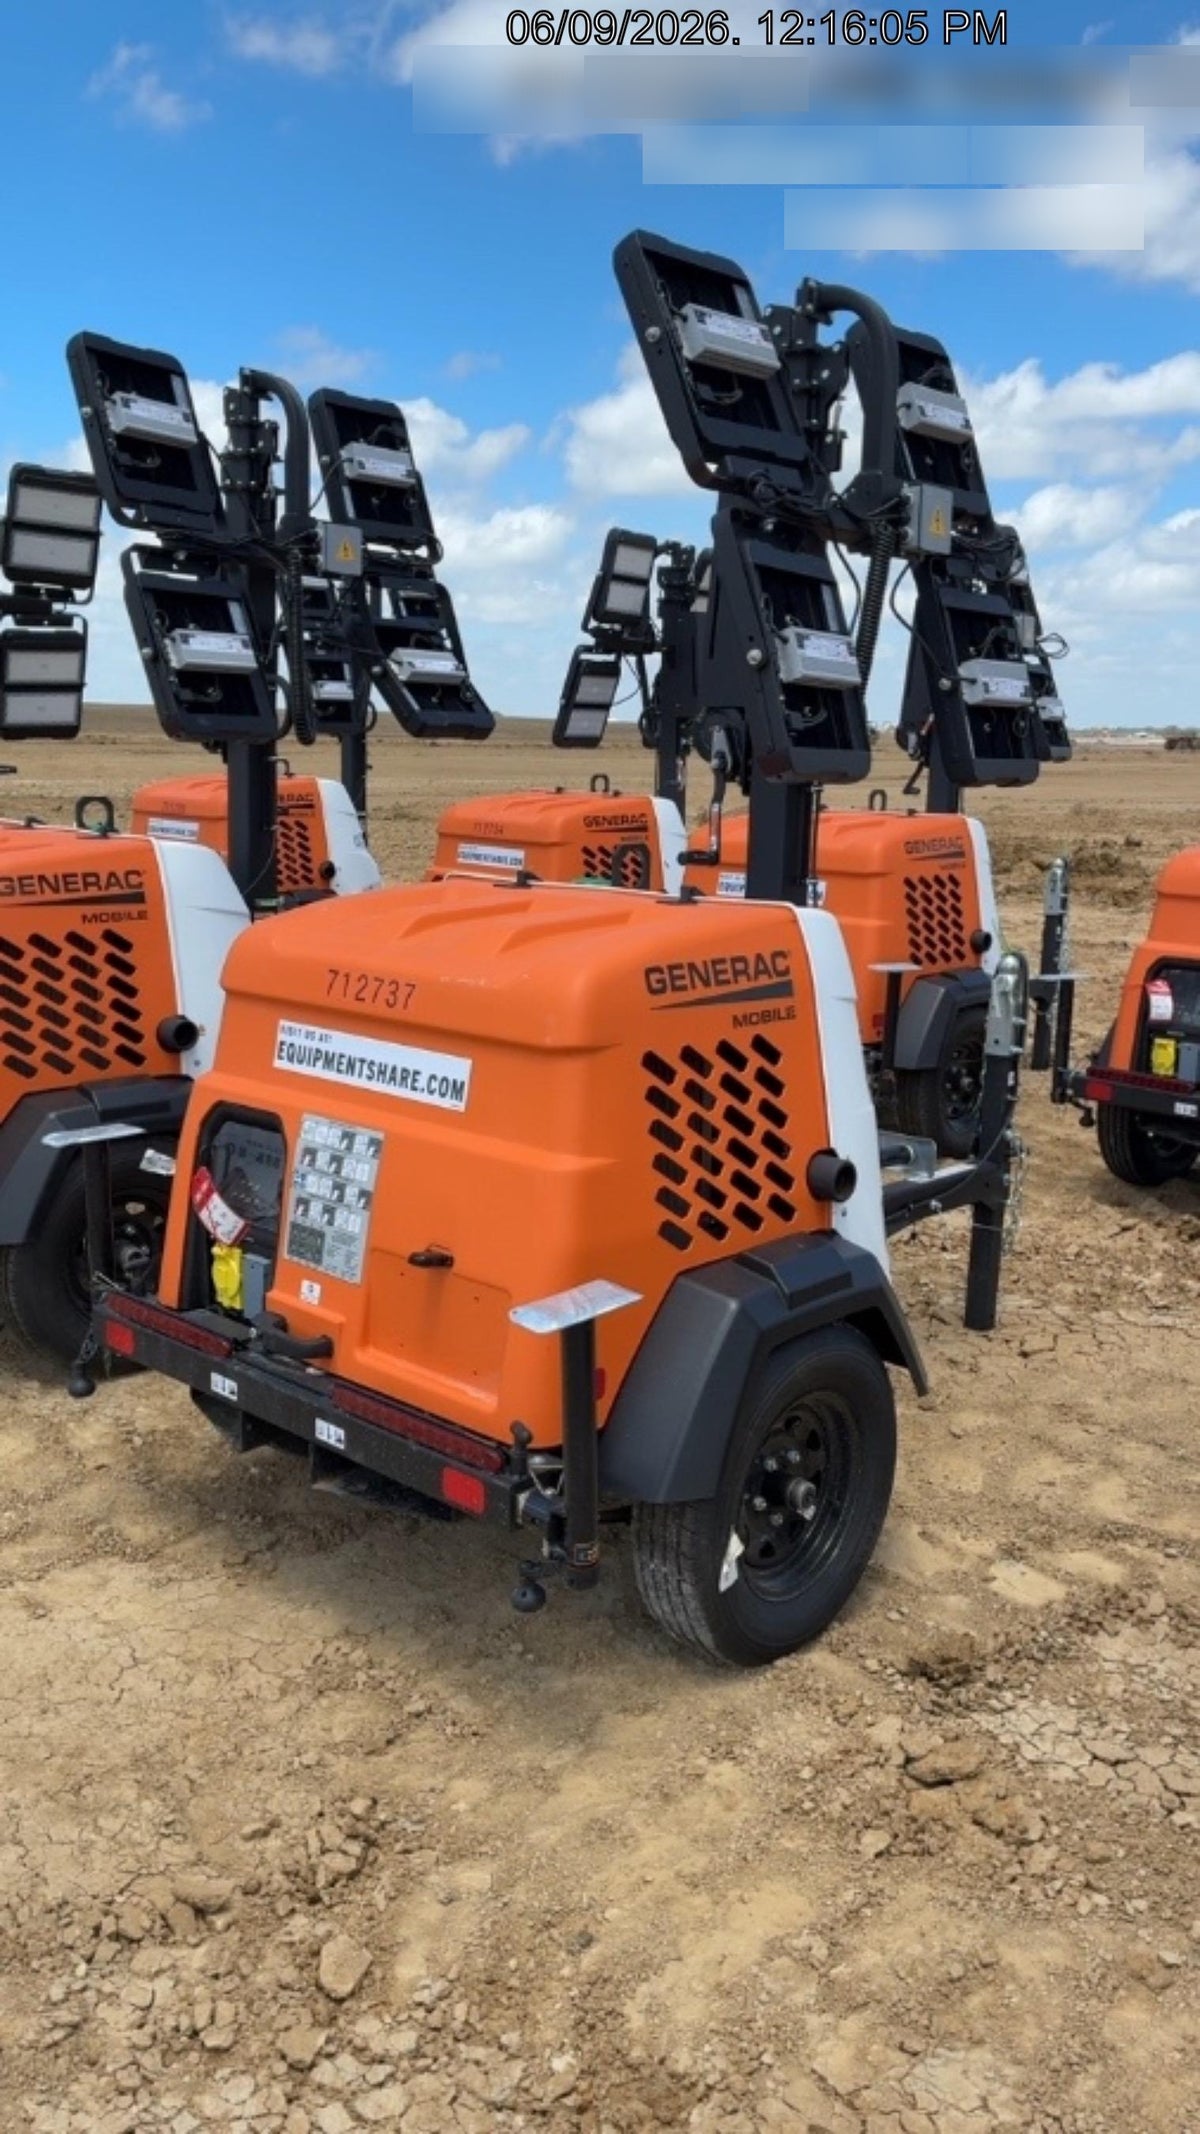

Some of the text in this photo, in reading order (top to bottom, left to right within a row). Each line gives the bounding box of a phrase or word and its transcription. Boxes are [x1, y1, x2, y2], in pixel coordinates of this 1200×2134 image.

[81, 910, 148, 924] MOBILE
[326, 969, 416, 1011] 712737
[644, 950, 790, 996] GENERAC
[732, 1005, 796, 1029] MOBILE
[277, 1040, 466, 1103] EQUIPMENTSHARE.COM
